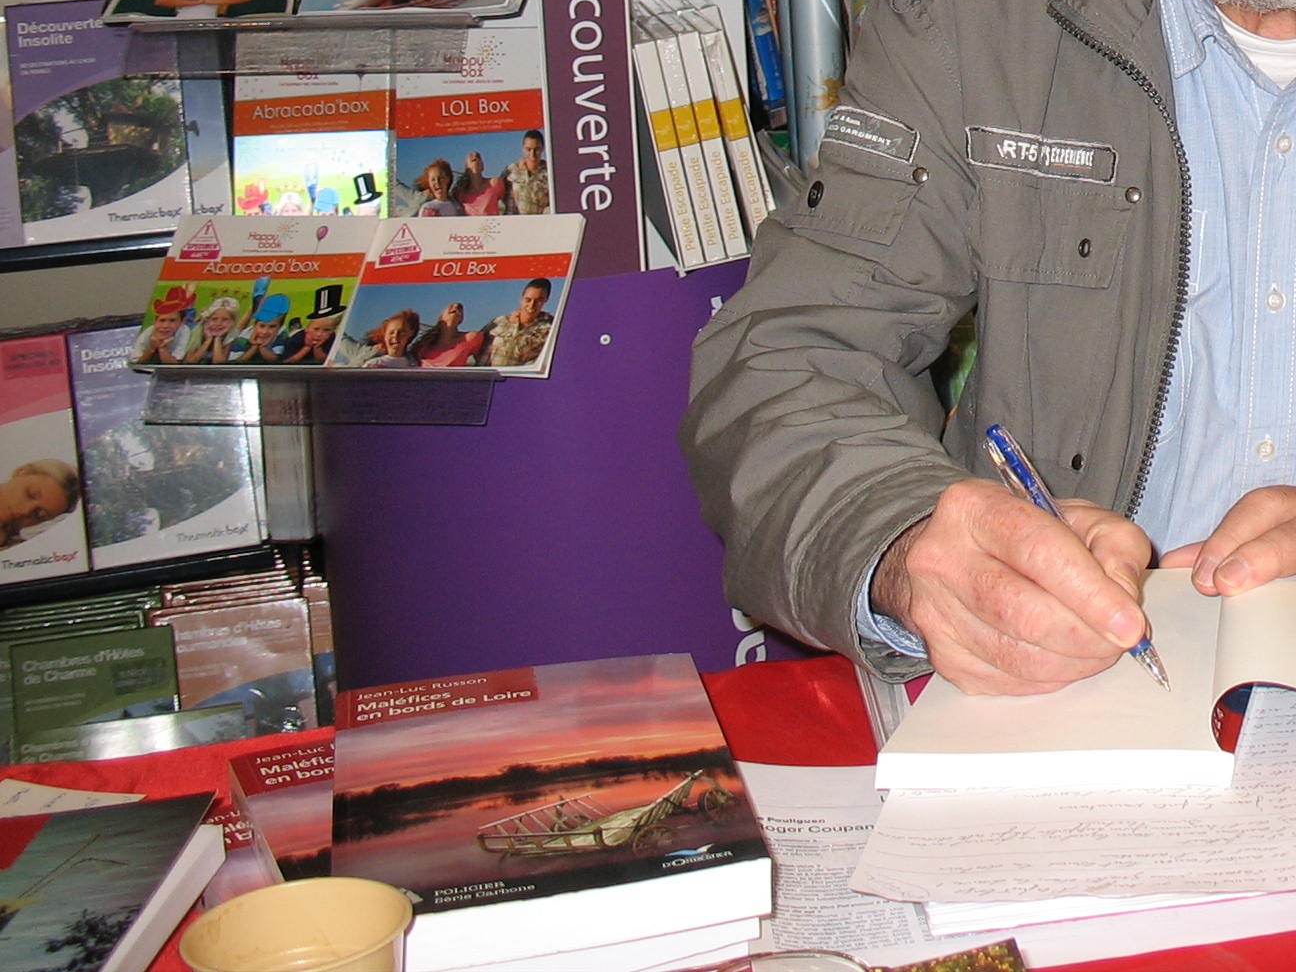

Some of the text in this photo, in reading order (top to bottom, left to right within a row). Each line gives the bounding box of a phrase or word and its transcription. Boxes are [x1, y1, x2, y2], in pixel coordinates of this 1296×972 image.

[17, 30, 74, 48] Insolite
[252, 98, 371, 121] Abracada'box
[440, 95, 511, 118] LOL Box
[668, 161, 696, 251] Petite Escapade
[691, 157, 717, 246] Petite Escapade
[712, 151, 739, 240] Petite Escapade
[202, 256, 320, 277] Abracada'box
[432, 259, 498, 278] LOL Box
[357, 677, 488, 701] Jean-Luc Russon
[356, 690, 452, 712] Maléfices
[356, 687, 533, 723] en bords de Loire
[767, 816, 826, 825] Pouliguen
[808, 823, 875, 836] Coupan
[434, 880, 507, 897] POLICIER
[434, 883, 537, 904] Série Carbone
